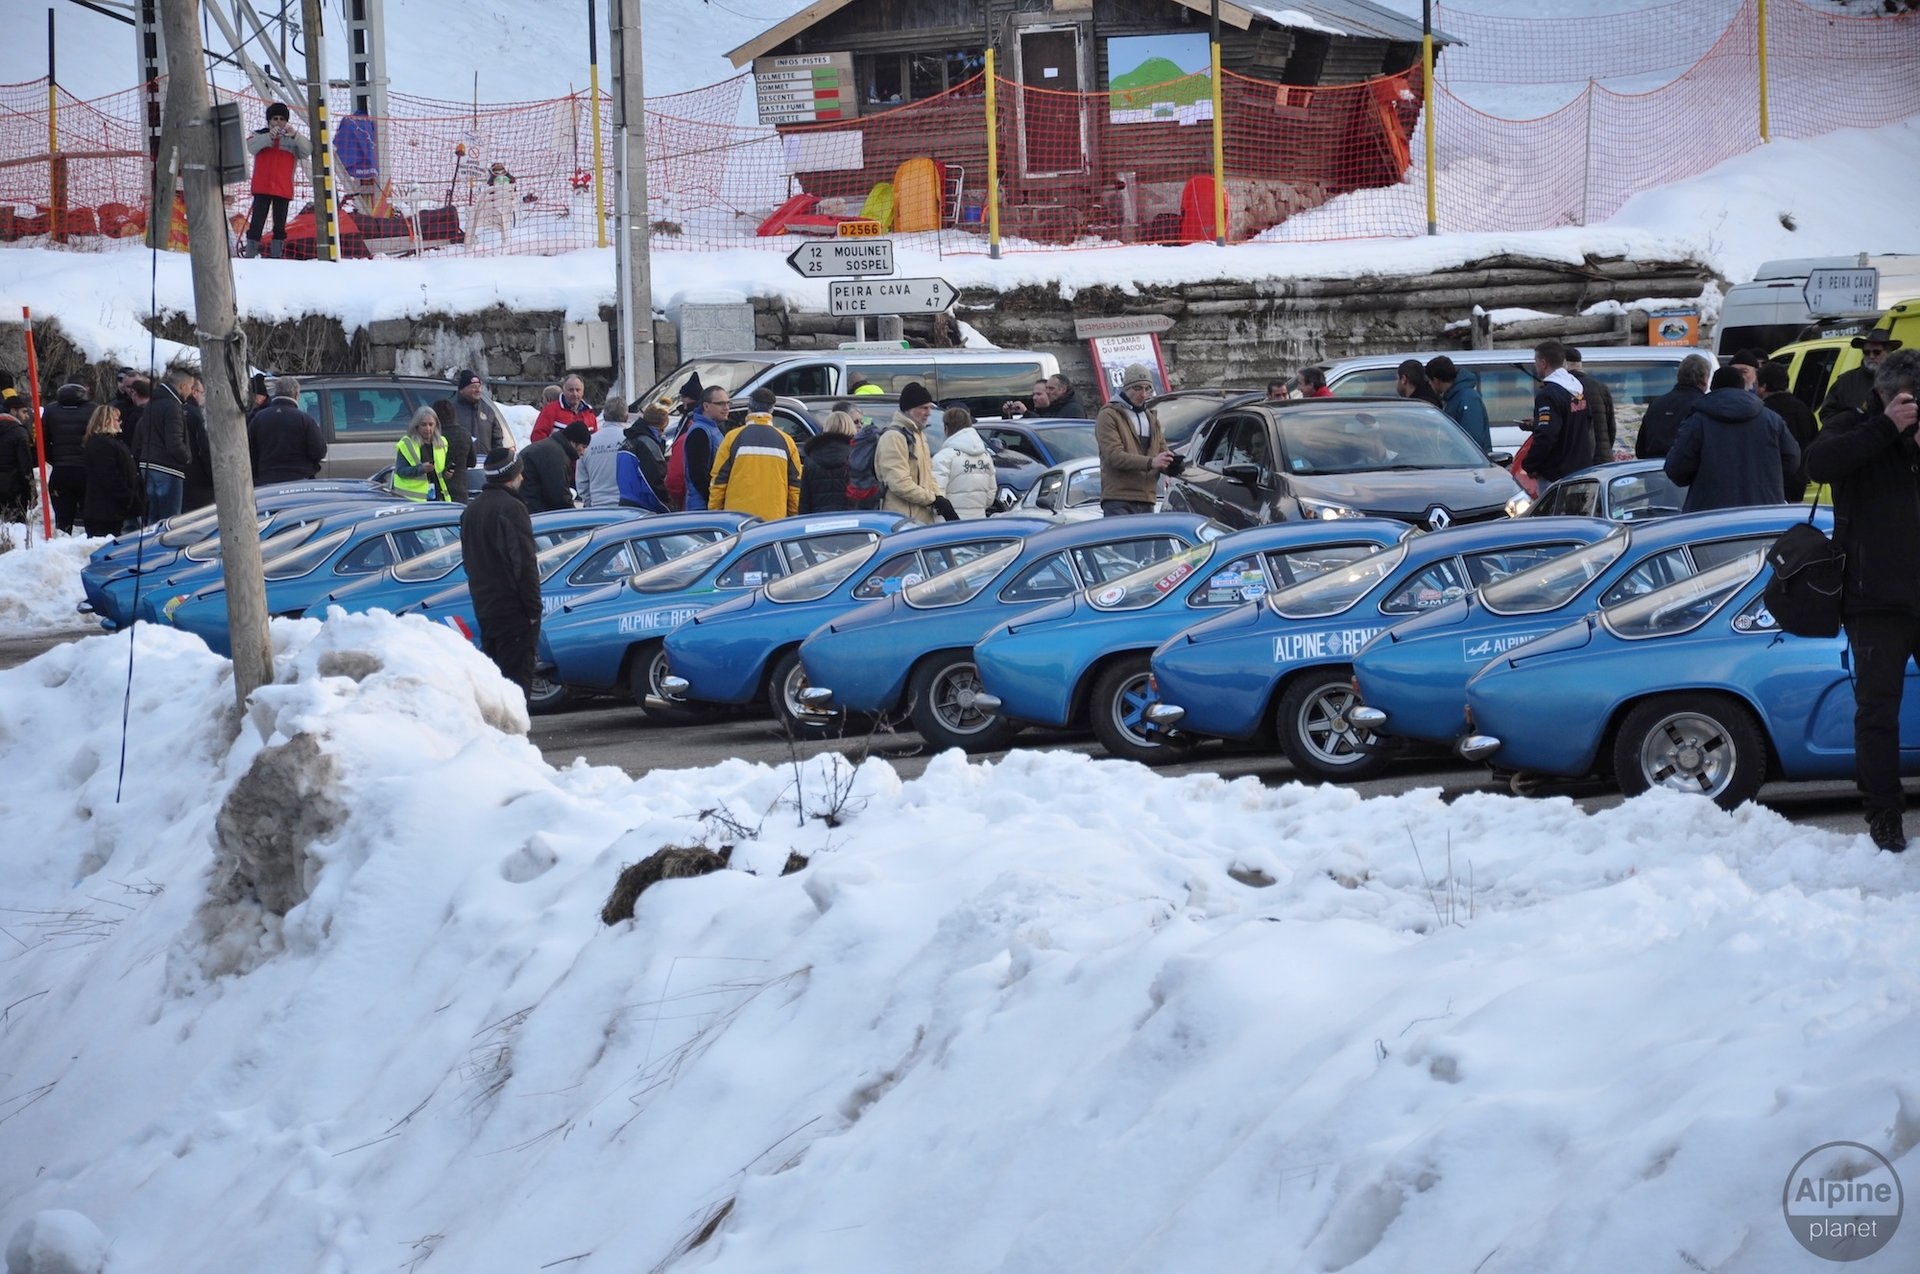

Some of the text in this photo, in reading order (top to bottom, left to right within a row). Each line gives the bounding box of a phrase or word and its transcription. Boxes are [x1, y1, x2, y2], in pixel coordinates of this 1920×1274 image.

[757, 73, 795, 81] CALMETTE
[760, 94, 795, 102] DESCENTE
[761, 115, 800, 124] CROISETTE
[811, 245, 887, 257] 12 MOULINET
[809, 260, 888, 271] 25 SOSPEL
[1818, 276, 1873, 289] 8 PEIRA CAVA
[835, 283, 940, 297] PEIRA CAVA 8
[835, 298, 940, 311] NICE 47
[1813, 294, 1873, 307] 47 NICE
[1103, 336, 1141, 347] LES LAMAS
[1114, 345, 1145, 353] MIRADOU
[620, 612, 661, 633] ALPINE
[1275, 633, 1327, 661] ALPINE
